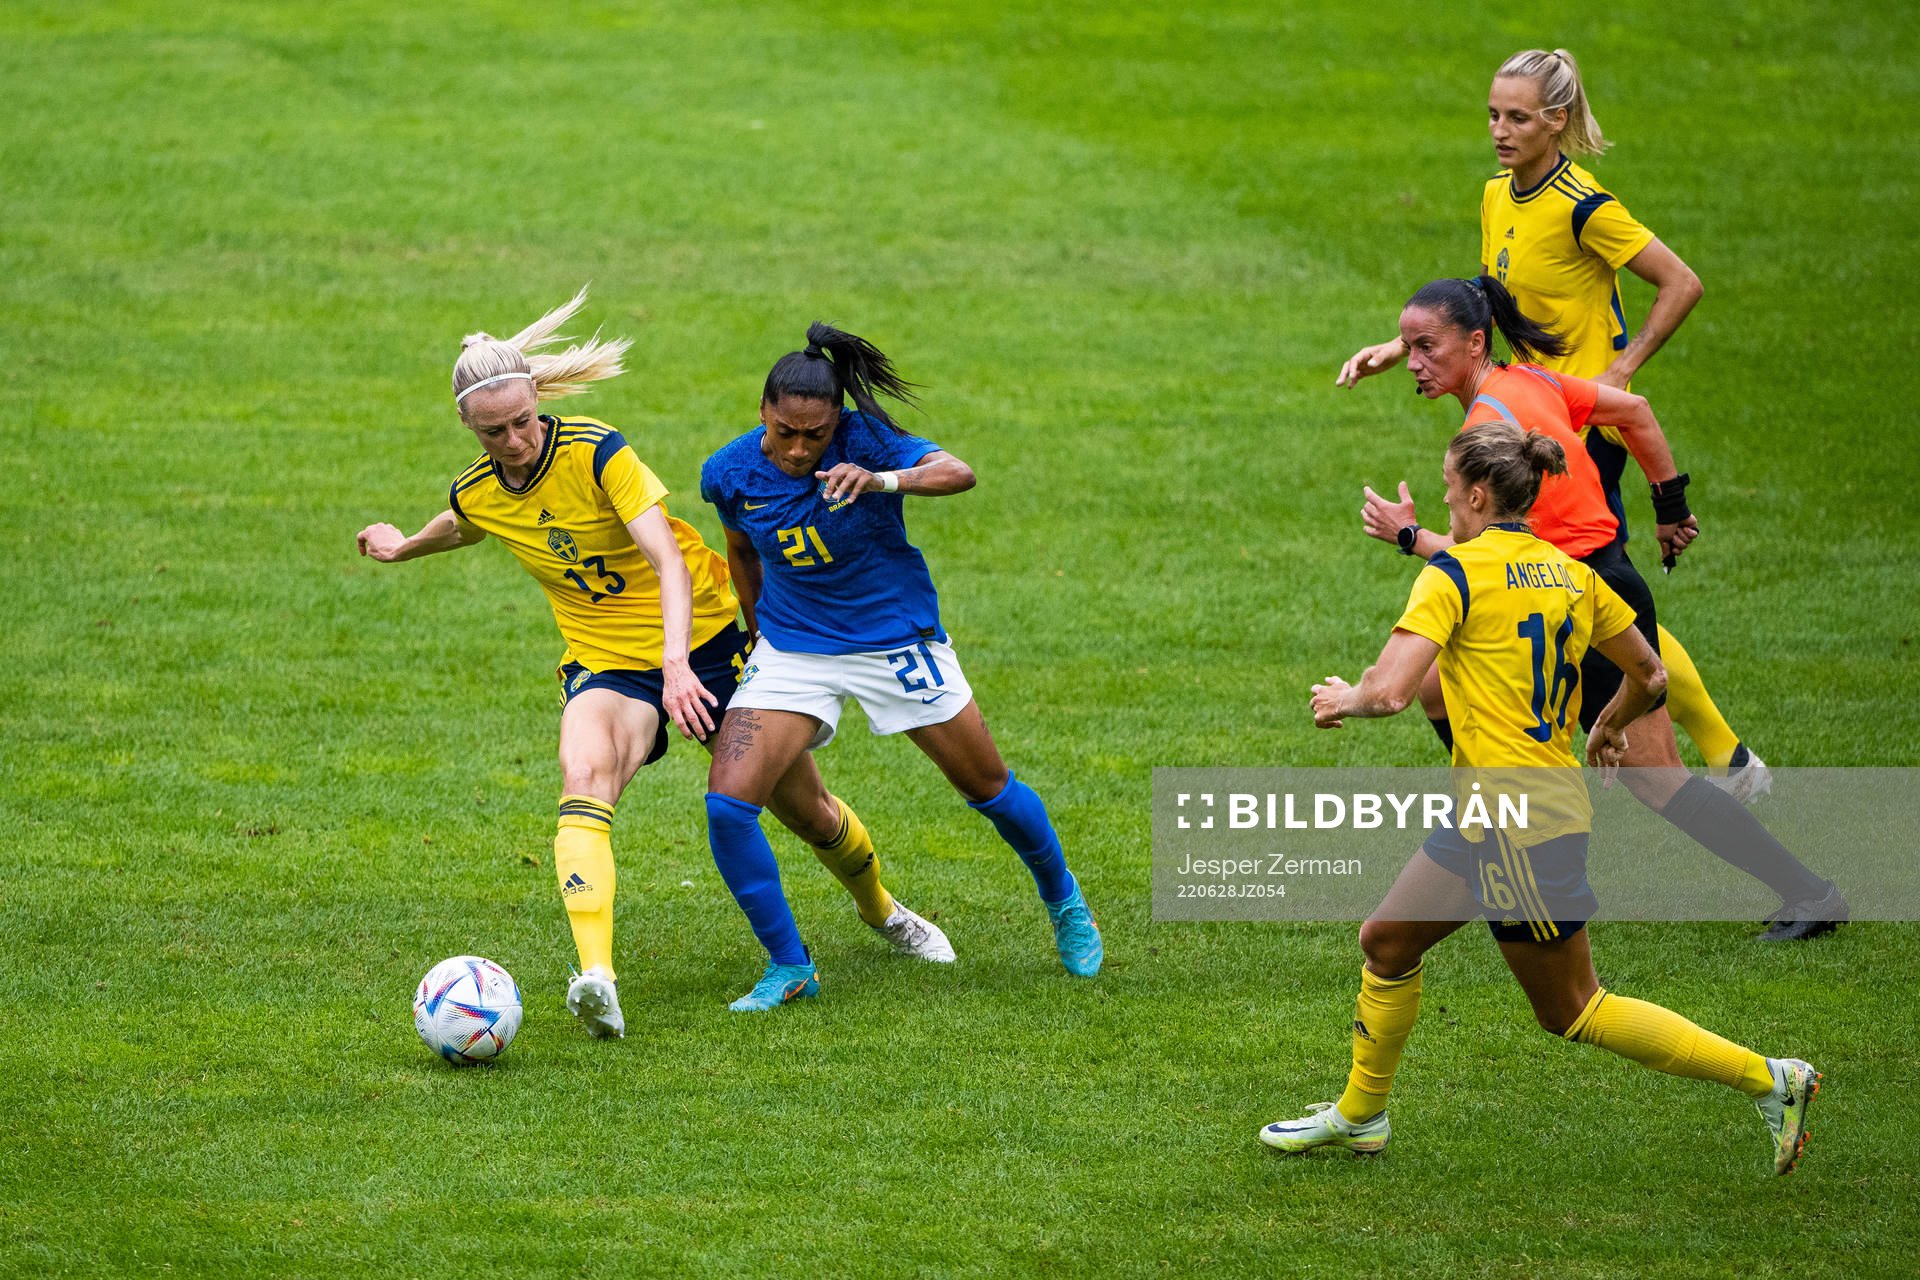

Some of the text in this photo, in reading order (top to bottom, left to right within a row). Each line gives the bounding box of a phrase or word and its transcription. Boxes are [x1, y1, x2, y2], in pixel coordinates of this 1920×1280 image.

[828, 498, 849, 513] BRASI
[777, 525, 834, 567] 21
[563, 555, 626, 603] 13
[886, 641, 945, 693] 21
[1517, 611, 1580, 743] 16
[1478, 859, 1517, 911] 16
